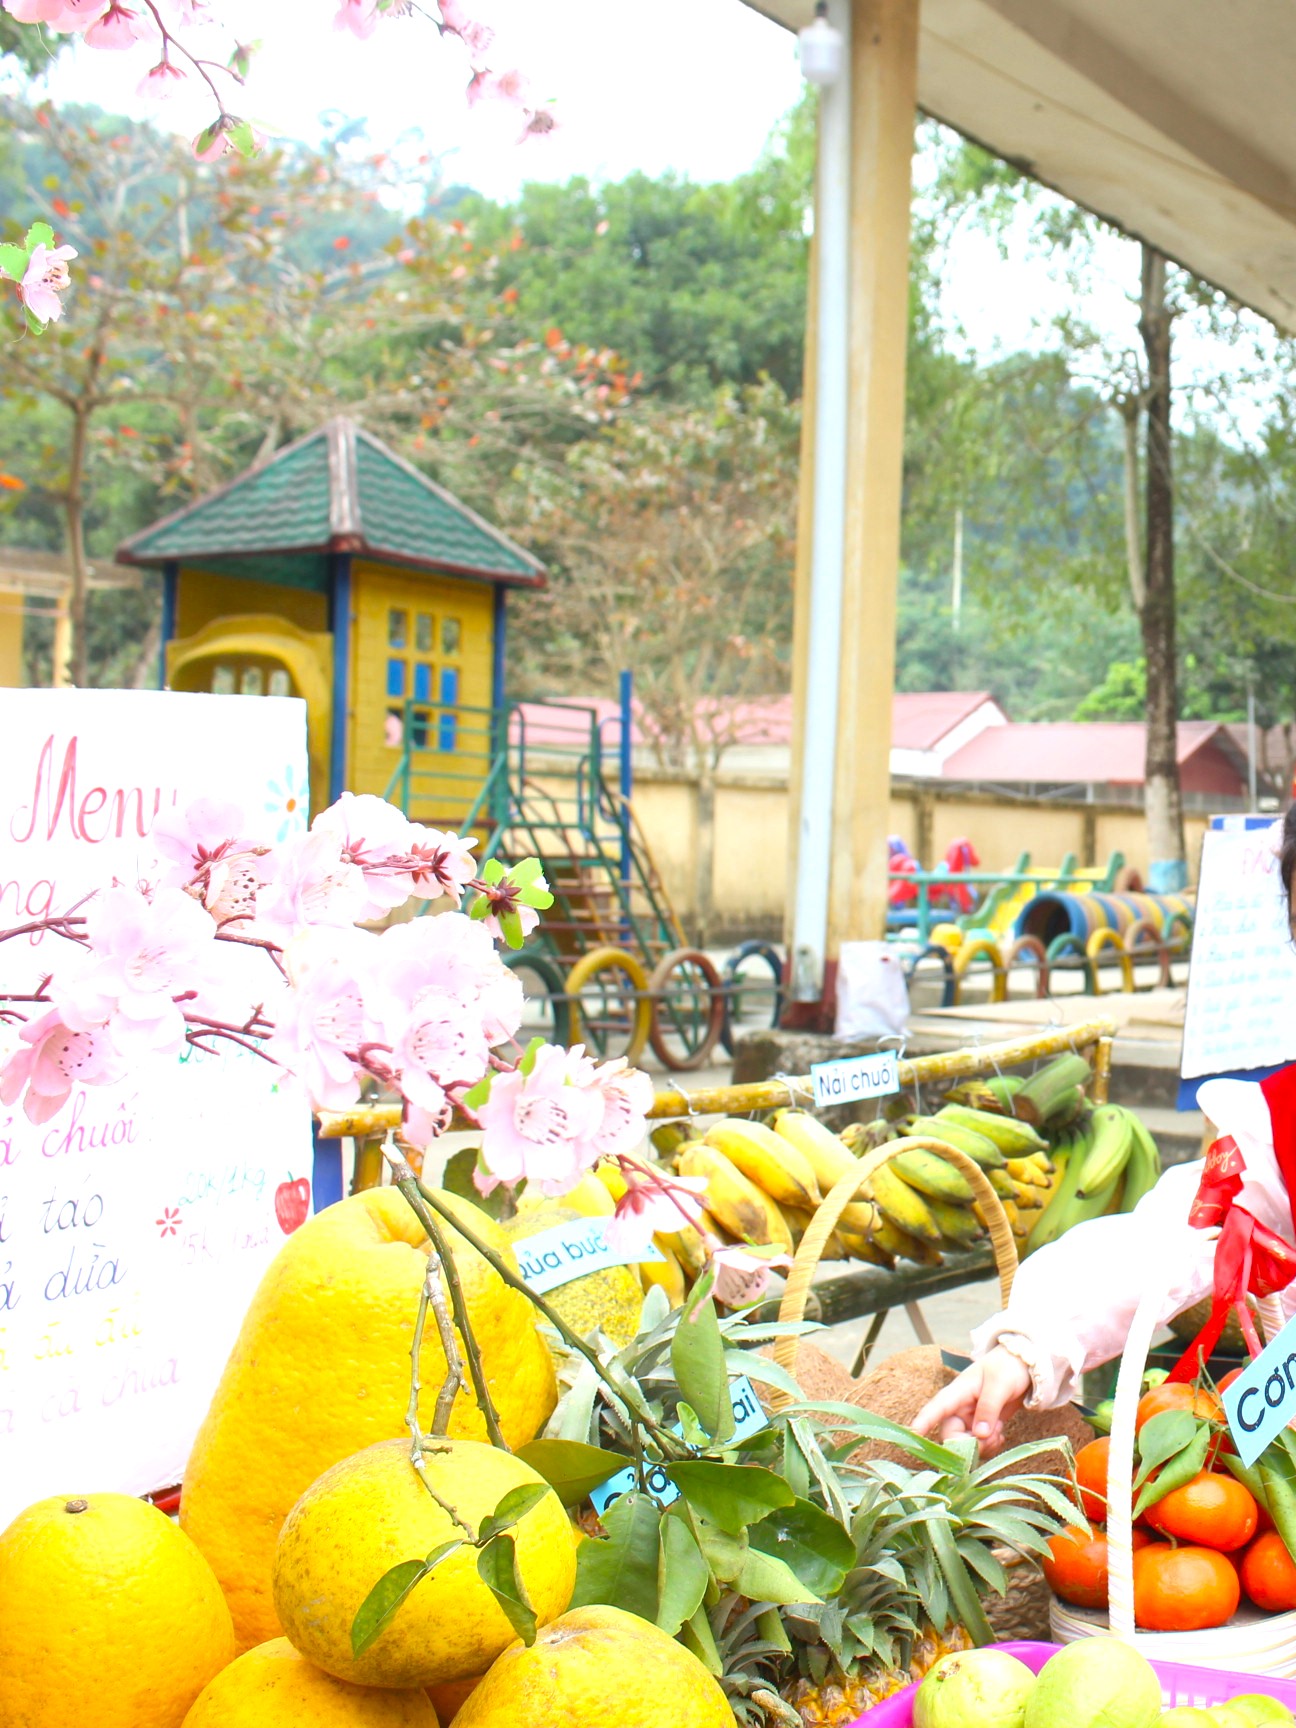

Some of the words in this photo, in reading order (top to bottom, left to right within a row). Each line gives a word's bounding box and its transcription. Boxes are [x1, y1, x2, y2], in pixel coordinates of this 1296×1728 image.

[819, 1068, 847, 1097] Nải
[851, 1059, 895, 1091] chuối
[41, 1090, 139, 1158] chuối
[40, 1172, 104, 1235] táo
[44, 1242, 129, 1301] dừa
